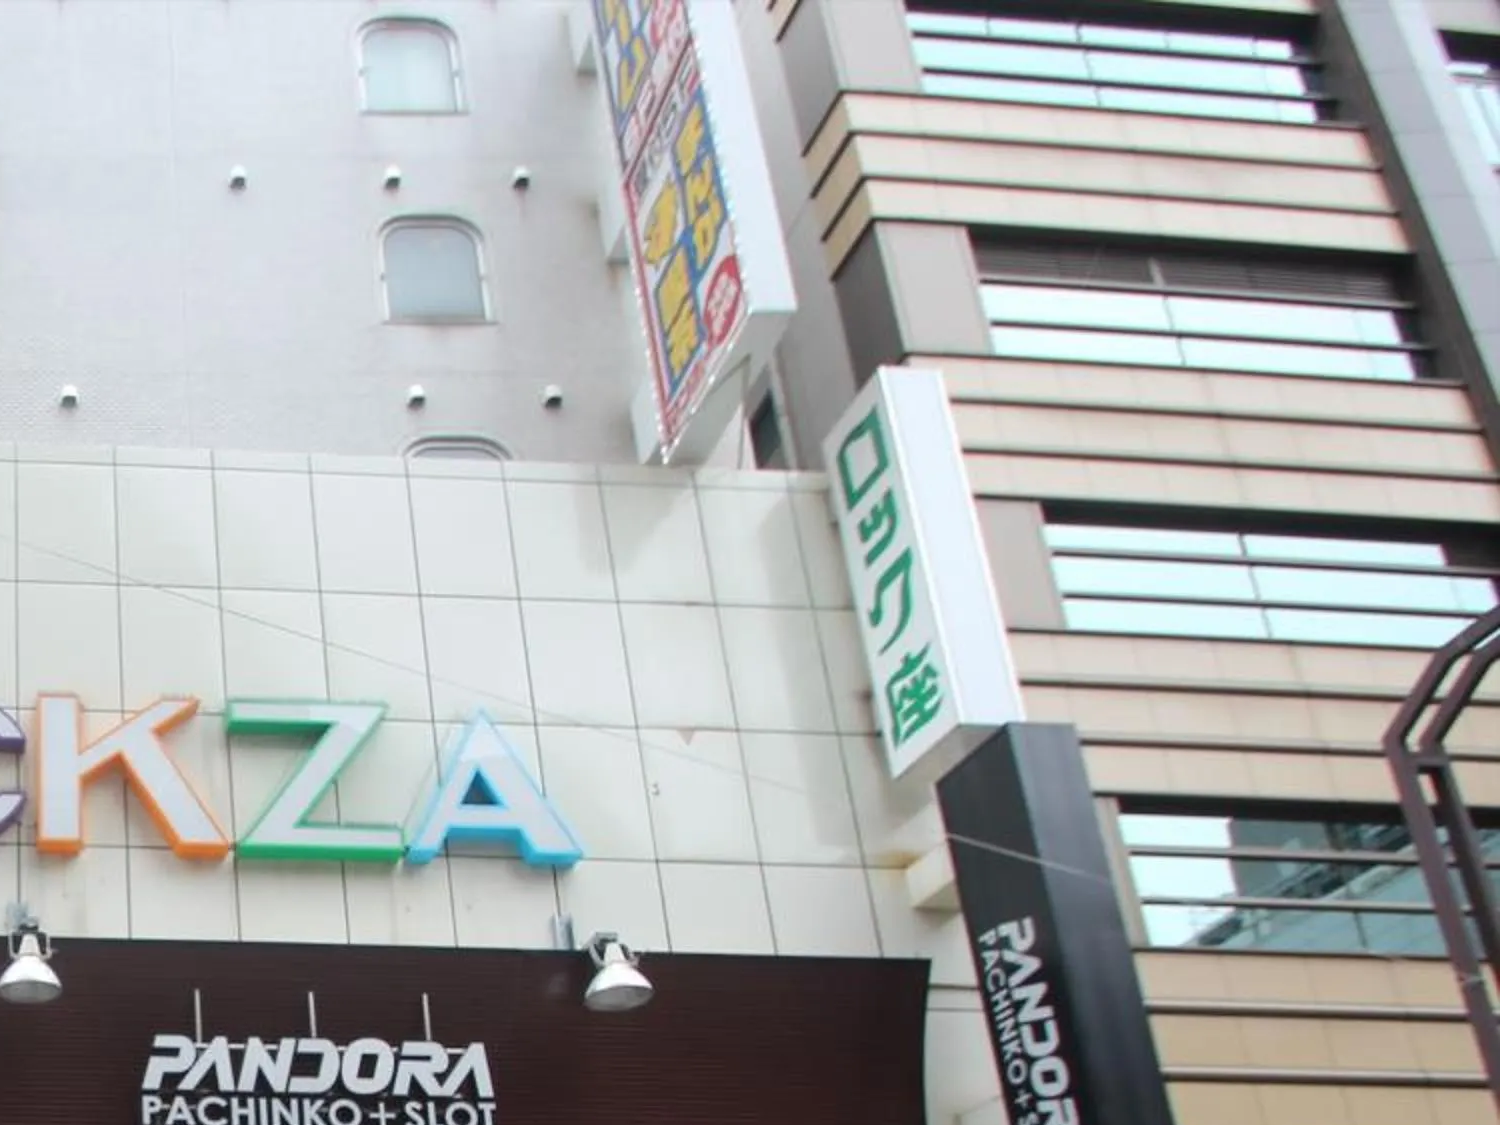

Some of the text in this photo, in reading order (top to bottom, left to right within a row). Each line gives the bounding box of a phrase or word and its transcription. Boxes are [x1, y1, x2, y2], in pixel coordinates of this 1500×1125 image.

[837, 404, 945, 752] ロック座
[141, 1034, 496, 1098] PANDORA
[978, 927, 1028, 1085] PACHINKO
